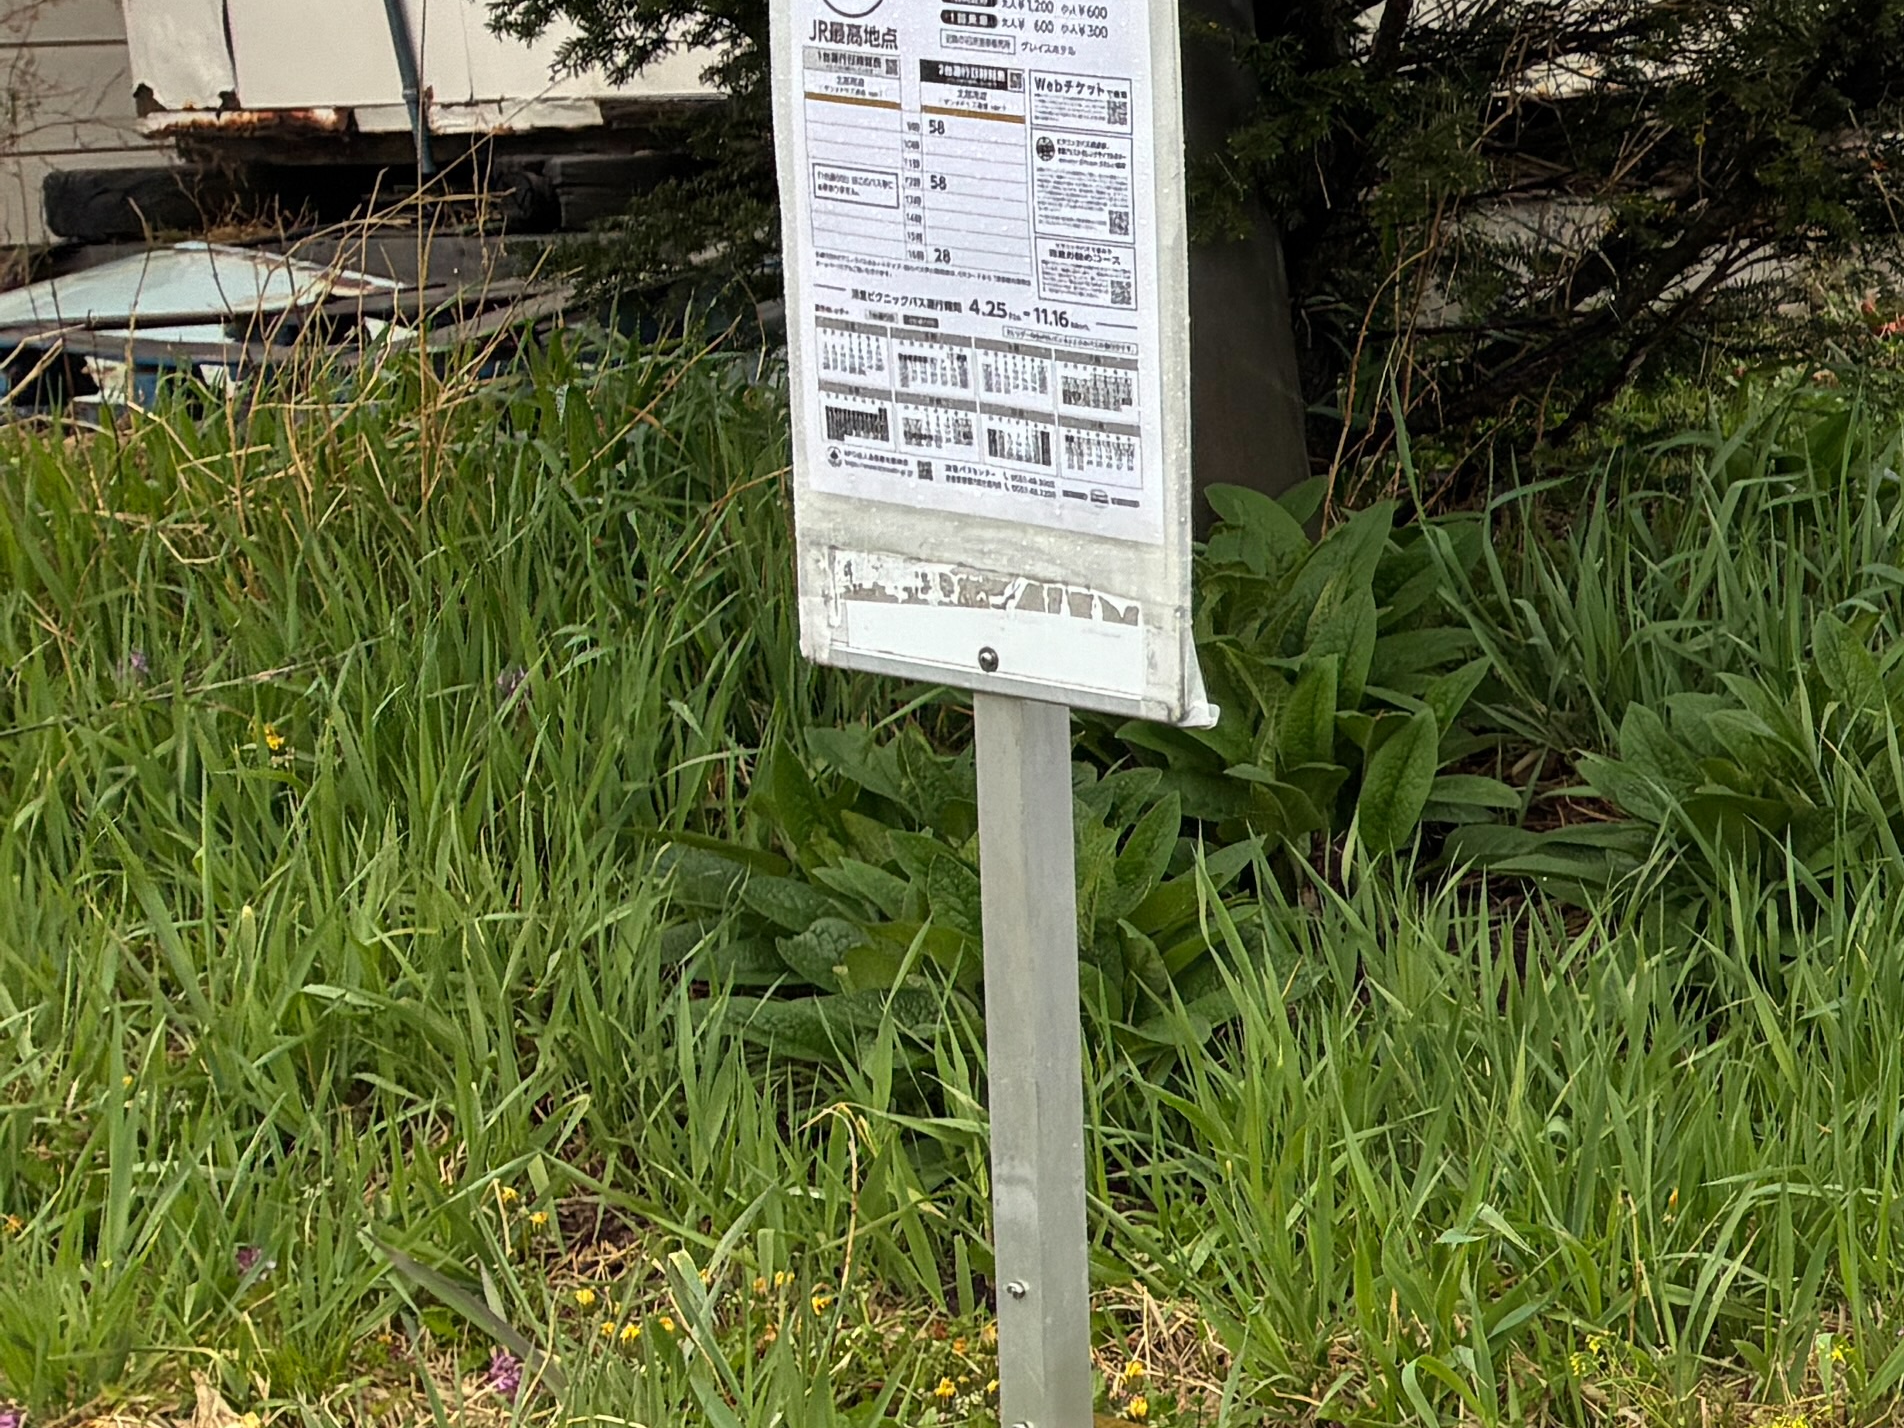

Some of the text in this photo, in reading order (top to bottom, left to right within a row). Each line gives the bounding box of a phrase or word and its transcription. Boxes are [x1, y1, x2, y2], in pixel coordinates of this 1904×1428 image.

[808, 18, 899, 51] JR最高地点
[928, 119, 946, 135] 58
[930, 174, 947, 191] 58
[933, 247, 952, 264] 28
[968, 298, 1007, 320] 4.25
[1033, 306, 1070, 329] 11.16
